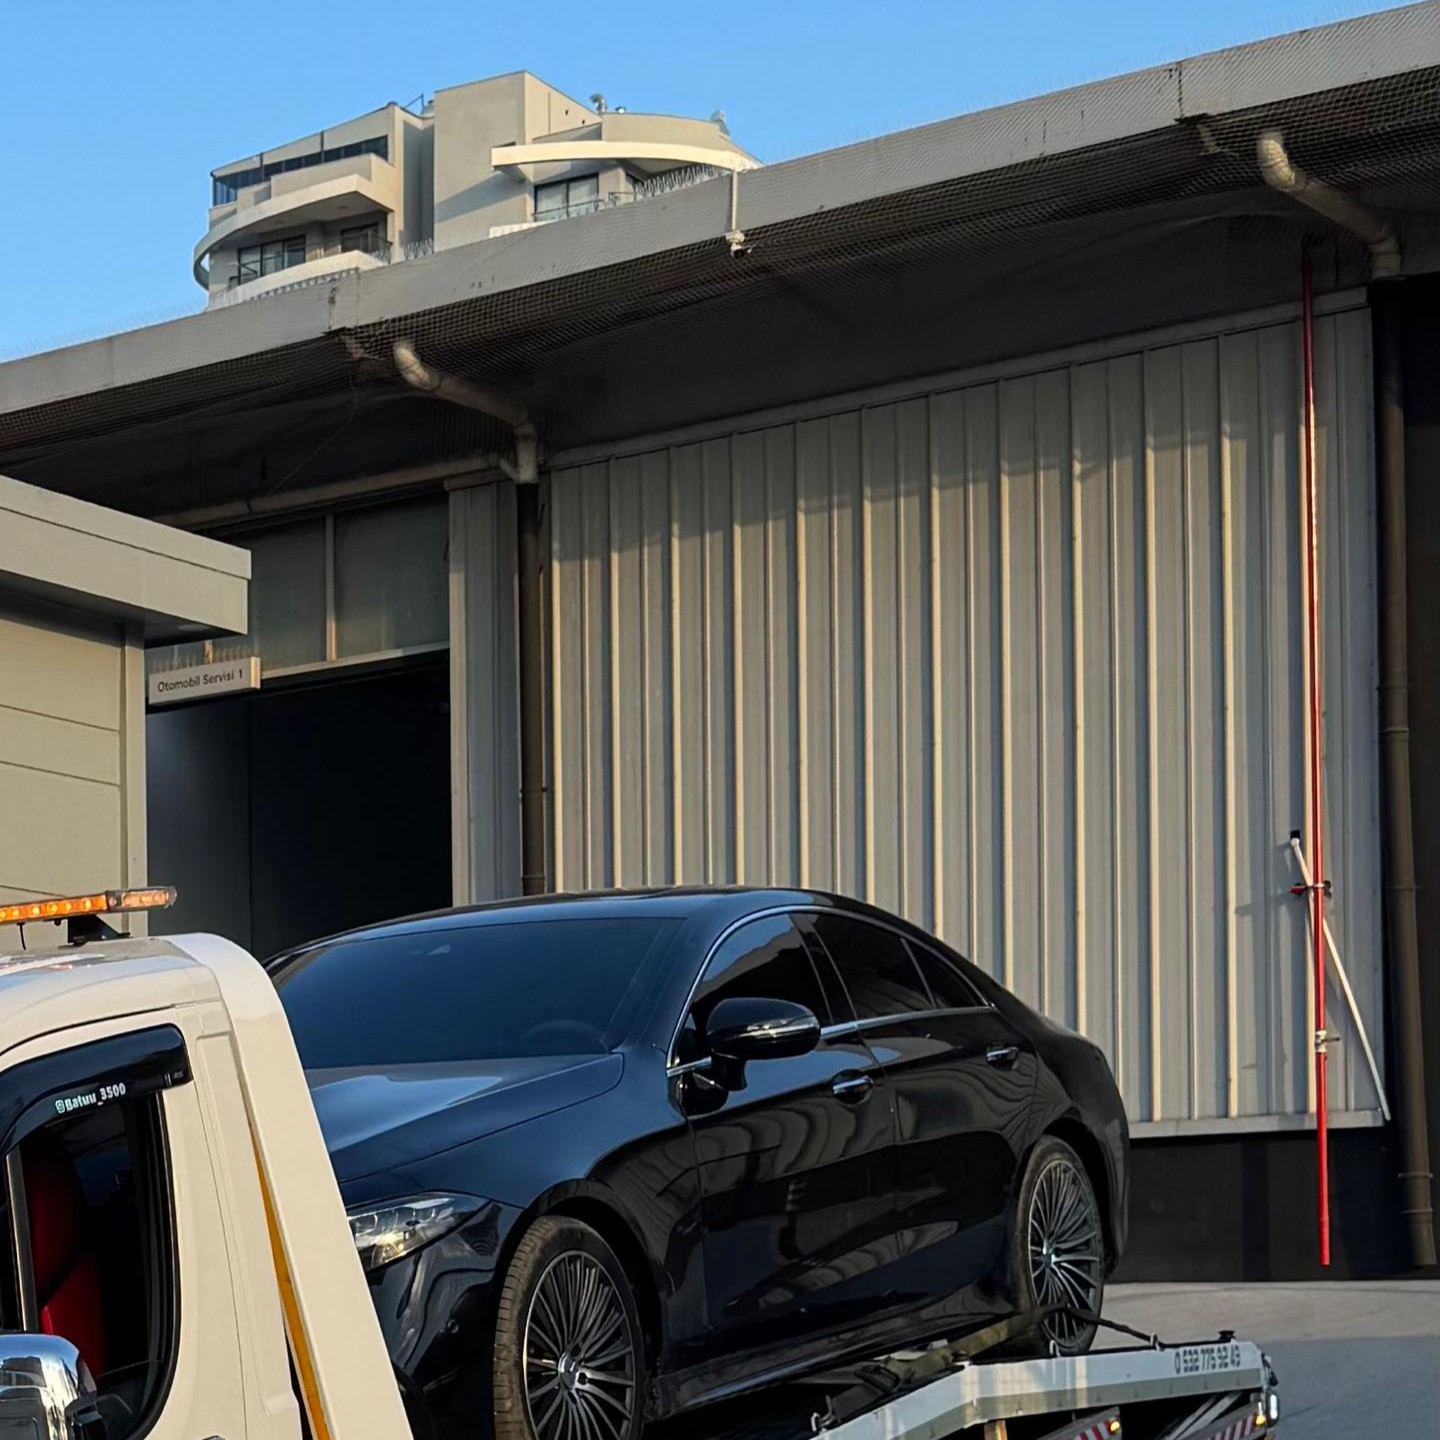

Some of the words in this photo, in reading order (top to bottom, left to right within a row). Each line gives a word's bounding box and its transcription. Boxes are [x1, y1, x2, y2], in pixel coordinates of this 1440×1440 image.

[158, 677, 200, 692] Otomobil
[203, 671, 234, 685] Servisi
[238, 669, 243, 679] 1
[1174, 1351, 1181, 1375] 0
